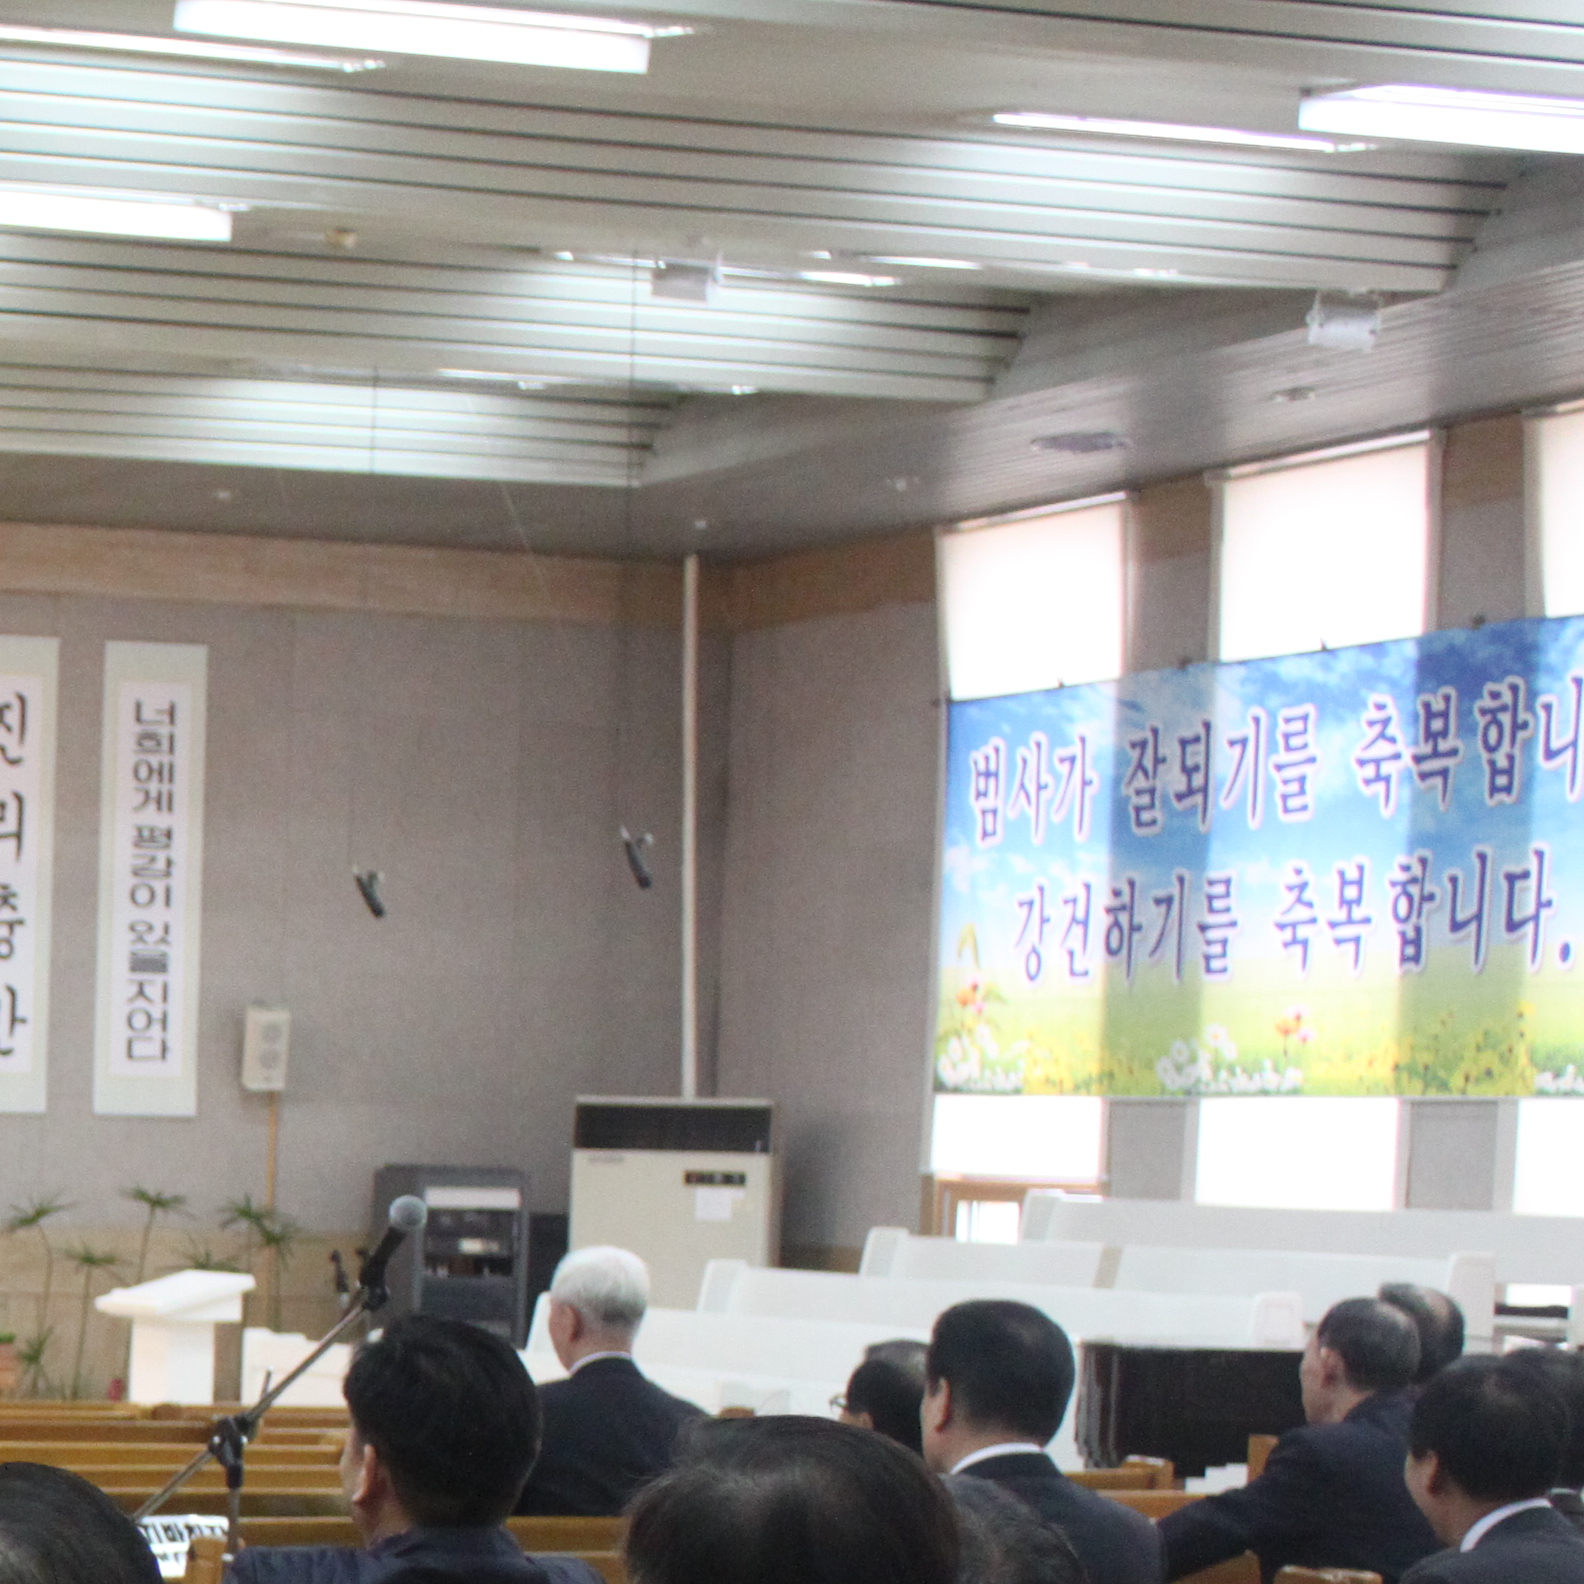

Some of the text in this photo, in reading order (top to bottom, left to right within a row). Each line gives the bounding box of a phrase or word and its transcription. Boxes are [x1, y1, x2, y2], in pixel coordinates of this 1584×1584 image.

[133, 699, 176, 814] 너희에게
[971, 734, 1095, 845] 범사가
[1122, 704, 1319, 834] 잘되기를
[130, 824, 175, 908] 평강이
[1014, 847, 1574, 985] 강건하기를 축복합니다.
